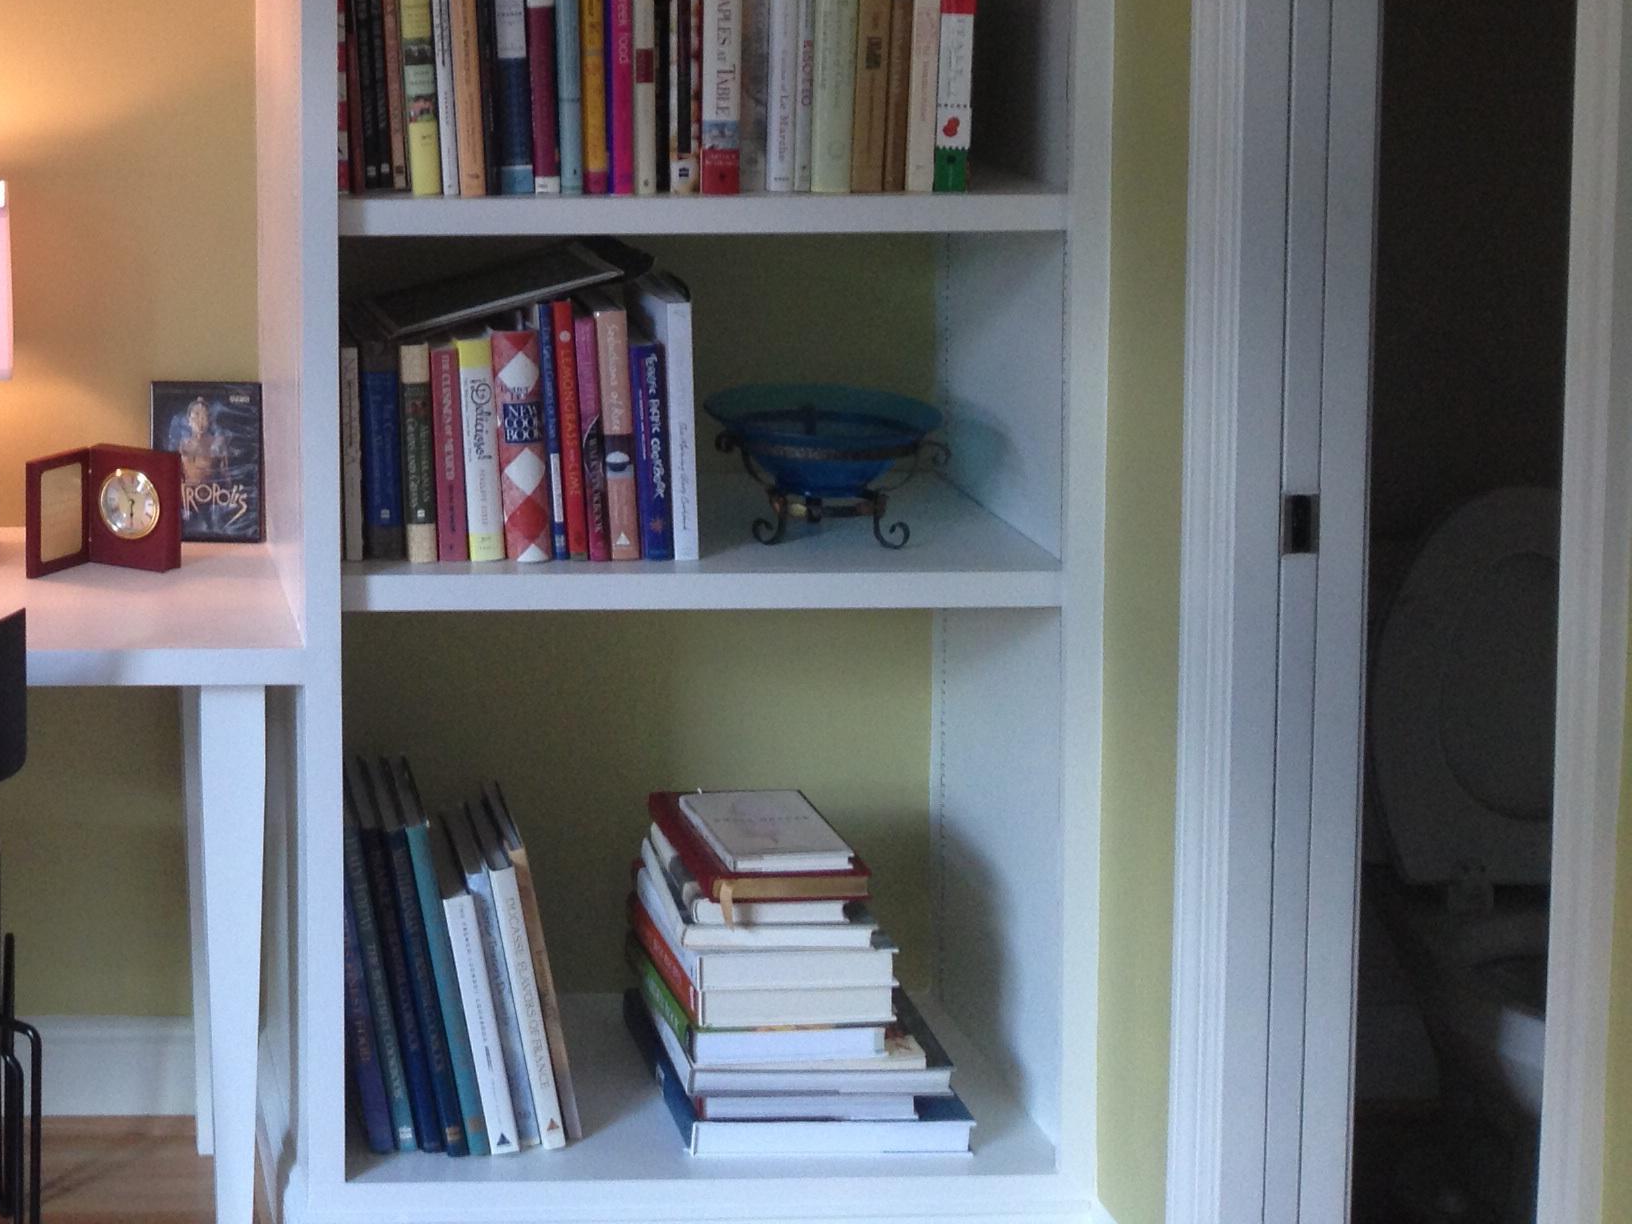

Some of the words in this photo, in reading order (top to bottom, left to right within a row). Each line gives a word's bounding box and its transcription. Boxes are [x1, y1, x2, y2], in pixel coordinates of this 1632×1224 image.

[618, 32, 630, 65] food
[715, 64, 736, 118] TABLE
[801, 39, 812, 106] RISOTTO
[779, 94, 790, 112] Le
[778, 115, 789, 162] Marche
[441, 353, 451, 371] THE
[606, 323, 620, 388] Seductions
[440, 373, 453, 424] CUISINES
[503, 405, 538, 419] NEW
[560, 349, 577, 447] LEMONGRASS
[608, 391, 624, 408] of
[504, 419, 541, 432] COOK
[505, 431, 542, 443] BOOK
[610, 408, 624, 434] Rice
[443, 438, 456, 481] MEXICO
[568, 463, 580, 497] LIME
[503, 896, 526, 955] DUCASSE
[514, 959, 538, 1018] FLAVORS
[384, 1034, 403, 1099] COOKBOOK
[528, 1039, 551, 1090] FRANCE
